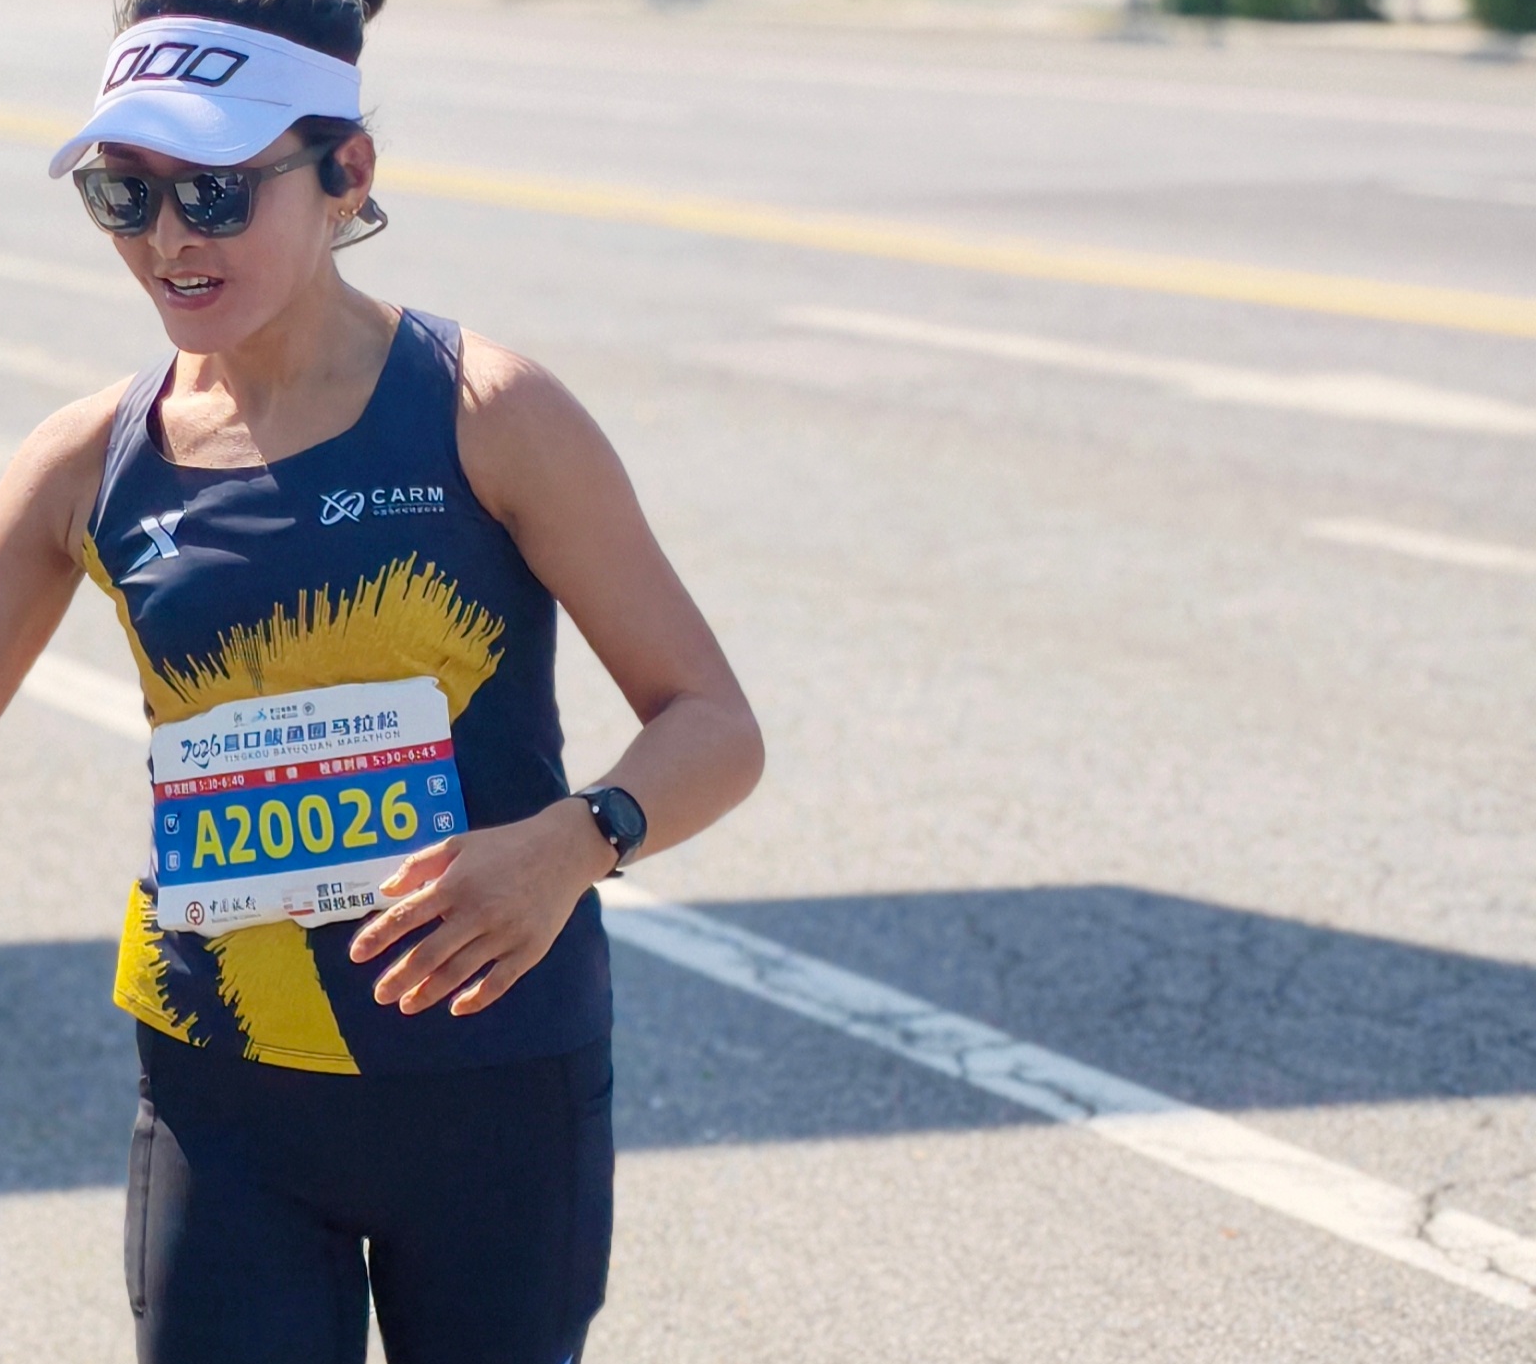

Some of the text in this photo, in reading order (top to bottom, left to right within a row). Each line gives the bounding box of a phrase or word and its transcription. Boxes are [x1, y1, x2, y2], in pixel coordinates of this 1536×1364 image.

[371, 486, 444, 504] CARM
[192, 781, 419, 869] A20026
[317, 882, 342, 897] 营口
[318, 892, 375, 912] 国投集团
